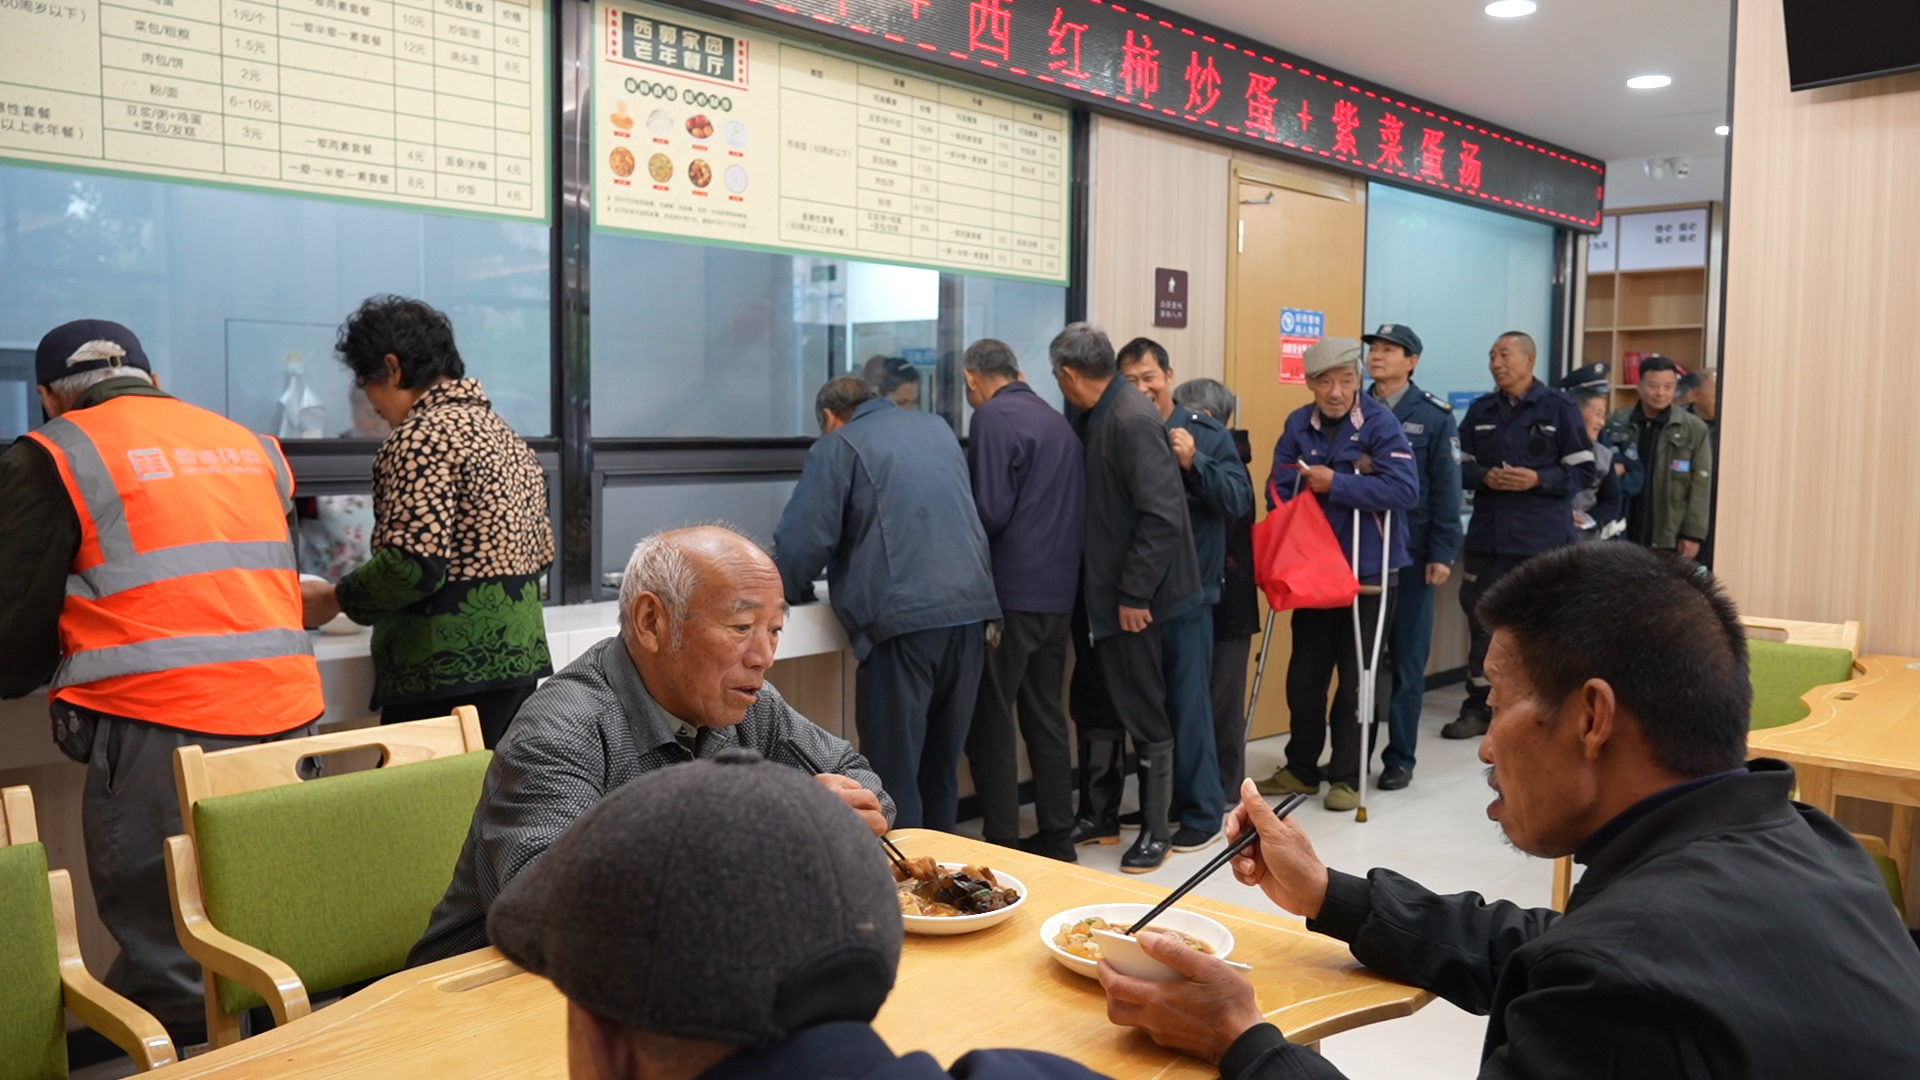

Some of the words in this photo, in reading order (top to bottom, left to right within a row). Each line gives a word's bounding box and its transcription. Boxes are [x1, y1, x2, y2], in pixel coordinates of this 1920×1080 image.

[402, 14, 425, 28] 10元
[235, 38, 266, 54] 1.5元
[504, 35, 520, 48] 4元
[402, 42, 425, 56] 12元
[633, 40, 725, 76] 老年餐厅
[241, 69, 261, 82] 2元
[837, 0, 1482, 190] 西红柿炒蛋+紫菜蛋汤
[242, 127, 262, 140] 3元
[407, 150, 424, 163] 4元
[506, 163, 521, 176] 4元
[506, 188, 521, 202] 4元
